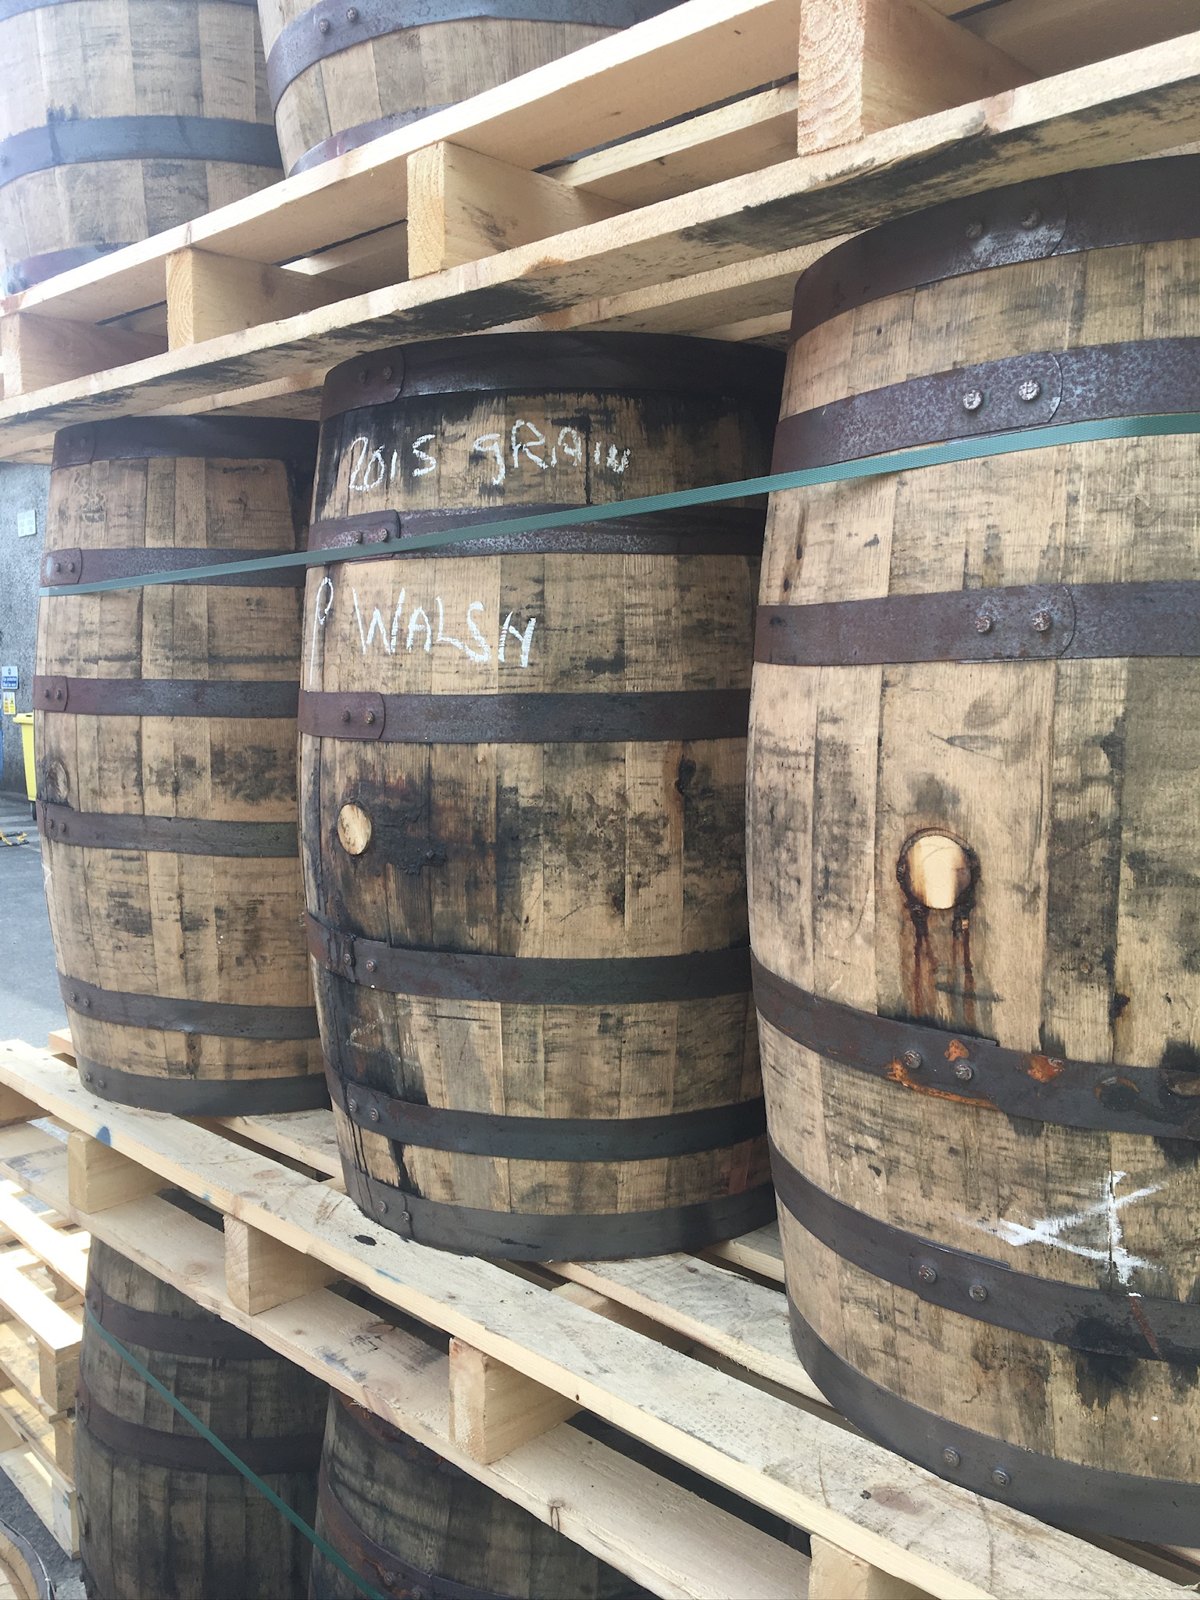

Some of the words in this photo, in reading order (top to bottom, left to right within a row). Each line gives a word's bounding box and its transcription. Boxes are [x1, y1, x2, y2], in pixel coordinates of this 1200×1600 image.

[349, 434, 436, 492] 2015
[309, 576, 334, 686] P
[352, 587, 537, 668] WALSH
